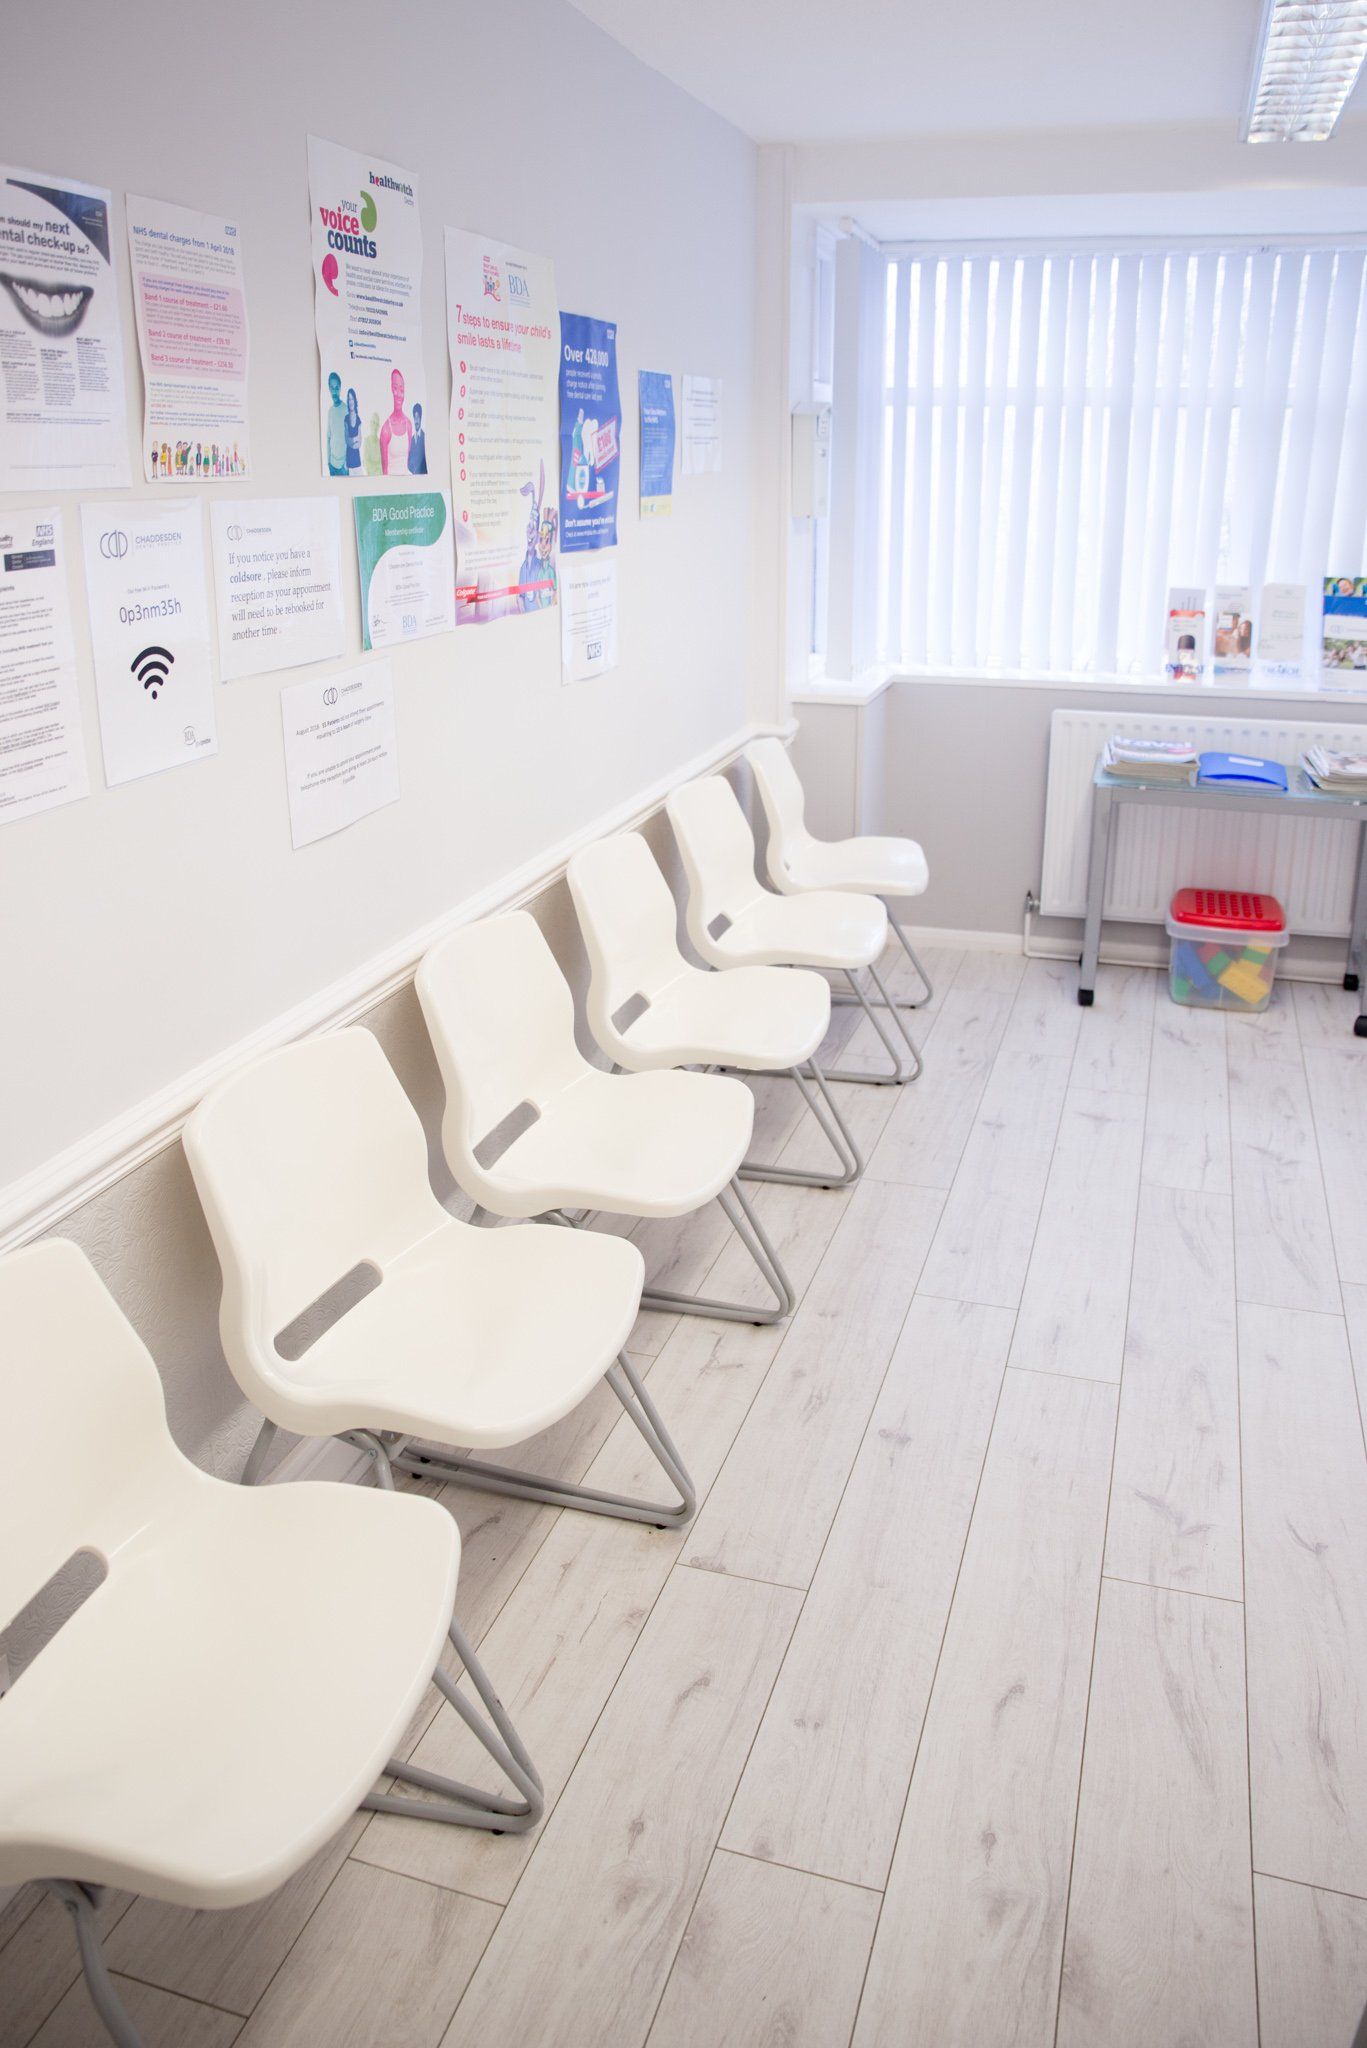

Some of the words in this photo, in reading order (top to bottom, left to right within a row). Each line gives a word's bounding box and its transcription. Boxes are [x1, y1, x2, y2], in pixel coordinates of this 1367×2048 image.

[369, 171, 413, 197] healthwatch
[341, 200, 357, 213] your
[8, 216, 31, 227] should
[32, 223, 44, 232] my
[45, 221, 70, 235] next
[320, 206, 360, 236] voice
[27, 232, 76, 255] check-up
[133, 226, 147, 236] NHS
[149, 228, 168, 240] dental
[169, 232, 192, 246] charges
[192, 238, 206, 248] from
[210, 243, 223, 253] April
[328, 230, 377, 259] counts
[508, 274, 530, 297] BDA
[144, 293, 159, 301] Band
[186, 299, 210, 308] treatment
[456, 304, 462, 323] 7
[463, 313, 481, 329] steps
[483, 316, 490, 328] to
[491, 320, 516, 332] ensure
[514, 322, 529, 336] your
[530, 324, 551, 339] child's
[148, 329, 163, 338] Band
[189, 334, 213, 343] treatment
[457, 333, 476, 347] smile
[478, 336, 495, 348] lasts
[496, 340, 501, 348] a
[151, 354, 166, 362] Band
[191, 358, 214, 367] treatment
[564, 345, 583, 362] Over
[372, 508, 388, 522] BDA
[389, 507, 410, 520] Good
[410, 505, 435, 519] Practice
[36, 524, 54, 537] NHS
[135, 531, 182, 544] CHADDESDEN
[31, 538, 54, 547] England
[229, 552, 236, 564] If
[236, 553, 252, 568] you
[252, 552, 275, 563] notice
[275, 551, 290, 565] you
[290, 548, 306, 560] have
[306, 550, 312, 558] a
[267, 568, 289, 583] please
[289, 566, 312, 578] inform
[231, 590, 265, 605] reception
[266, 590, 274, 599] as
[275, 587, 291, 601] your
[292, 583, 331, 598] appointment
[456, 588, 476, 599] Colgate
[231, 608, 246, 621] will
[247, 606, 265, 620] need
[266, 606, 275, 617] to
[275, 604, 284, 616] be
[285, 600, 315, 615] rebooked
[315, 599, 325, 610] for
[402, 615, 417, 628] BDA
[232, 626, 261, 641] another
